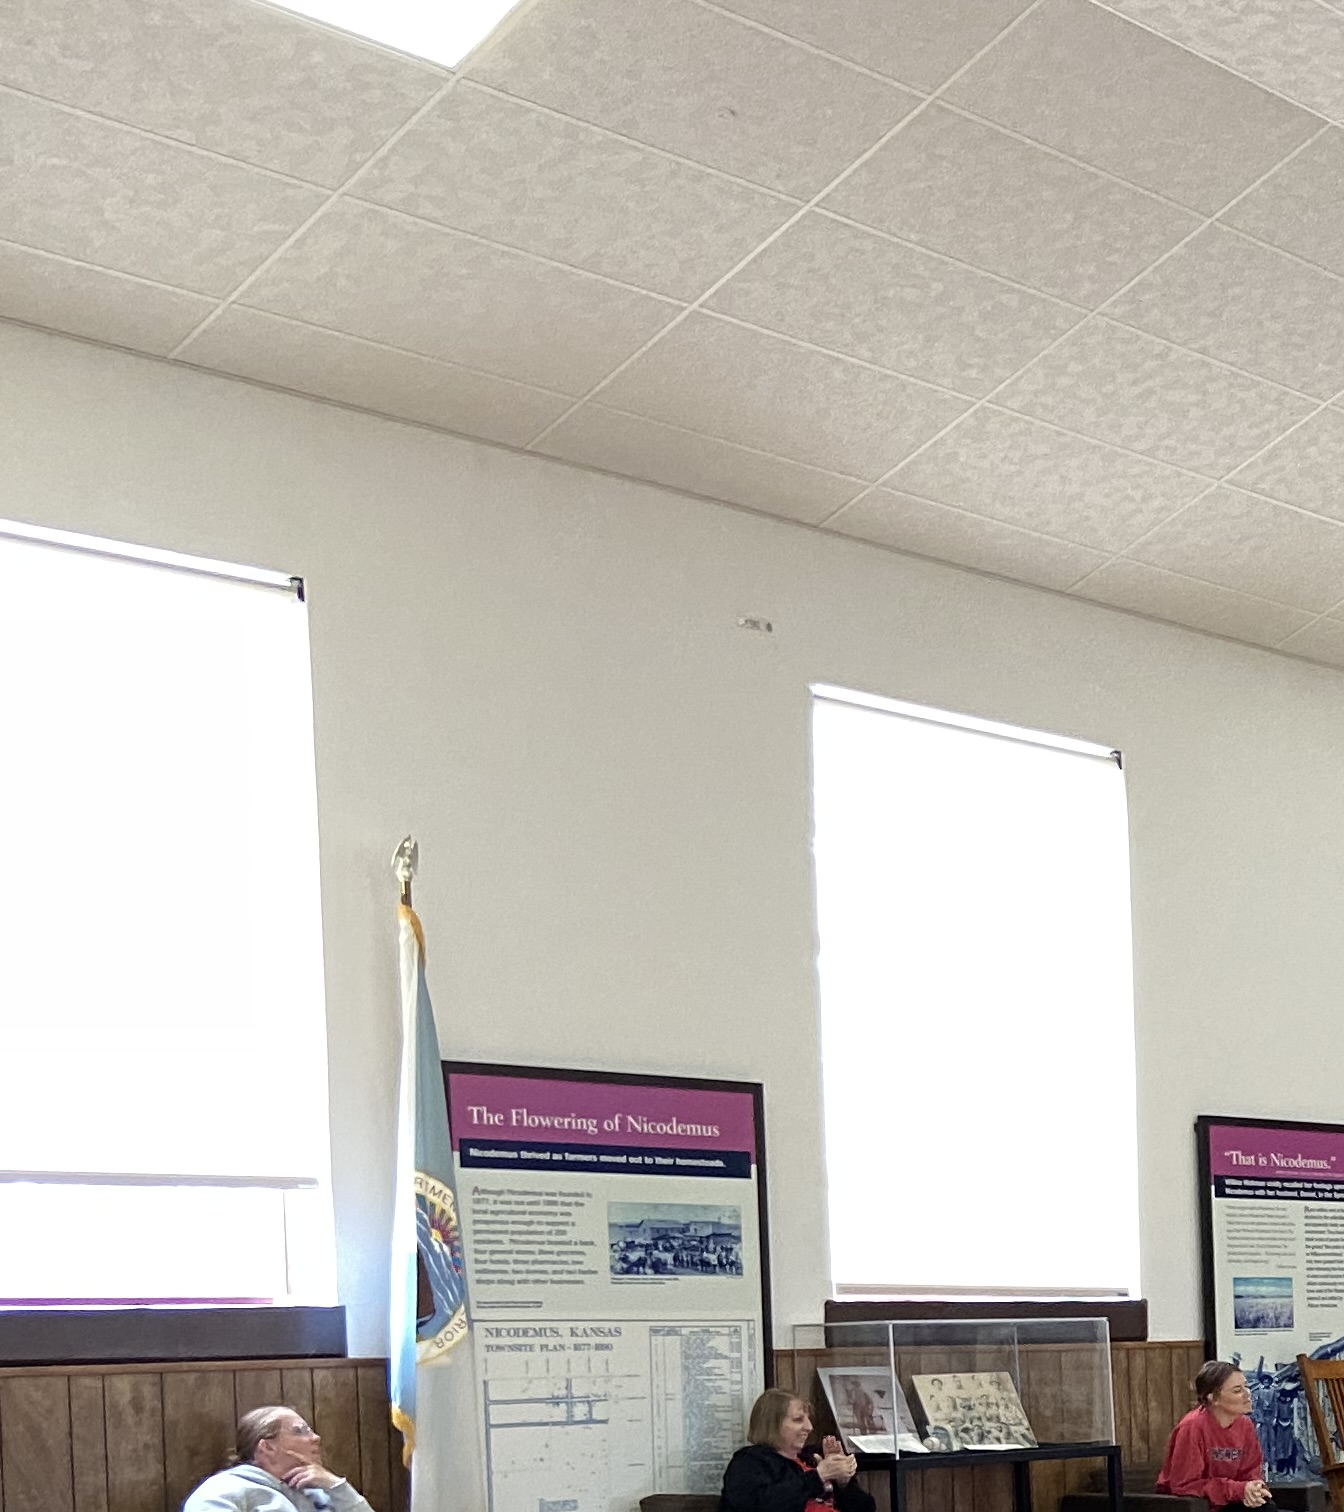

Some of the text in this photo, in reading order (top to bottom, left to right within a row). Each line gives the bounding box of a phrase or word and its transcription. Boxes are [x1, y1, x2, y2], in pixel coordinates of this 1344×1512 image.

[467, 1105, 720, 1138] The Flowering of Nicodemus
[1224, 1150, 1255, 1166] "That
[1258, 1153, 1268, 1167] is
[570, 1327, 622, 1338] KANSAS
